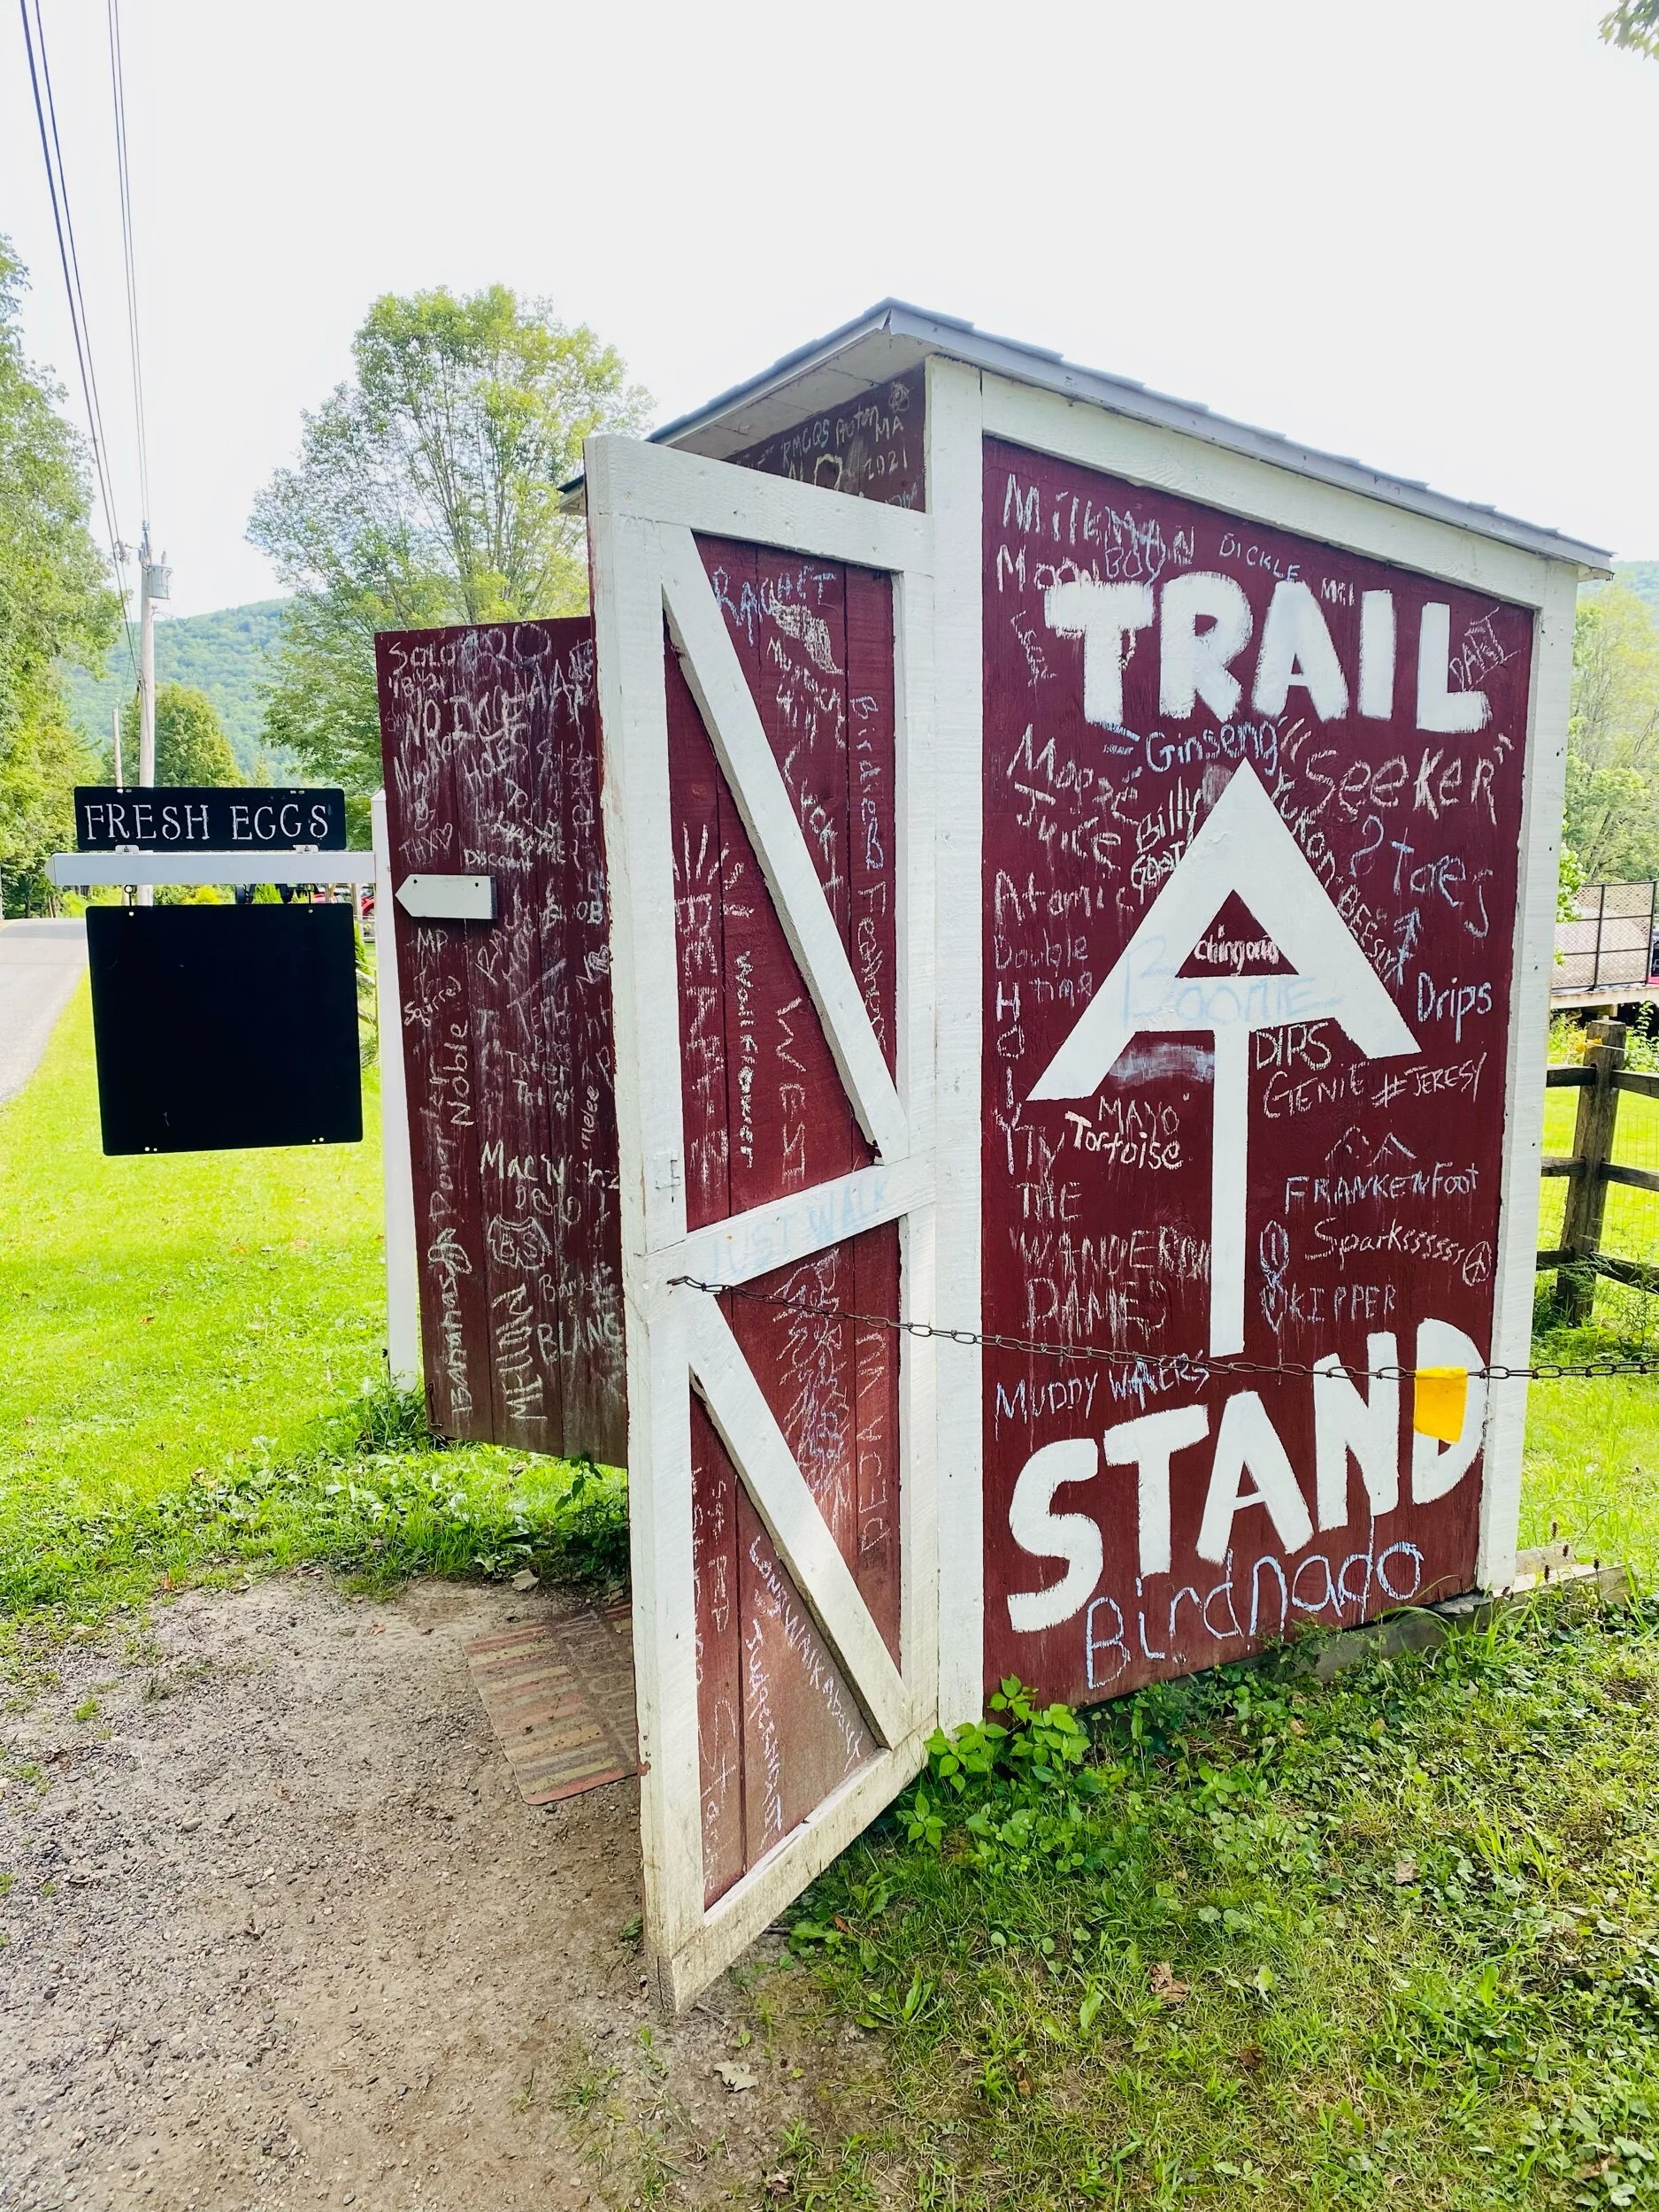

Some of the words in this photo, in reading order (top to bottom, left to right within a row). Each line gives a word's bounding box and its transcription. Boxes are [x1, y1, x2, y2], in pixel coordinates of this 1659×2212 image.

[1044, 571, 1493, 734] TRAIL
[84, 803, 211, 841] FRESH
[231, 803, 329, 841] EGGS
[1417, 972, 1493, 1043] Drips
[443, 1019, 475, 1126] Noble
[1064, 1110, 1184, 1170] Tortoise
[1007, 1317, 1488, 1633] STAND
